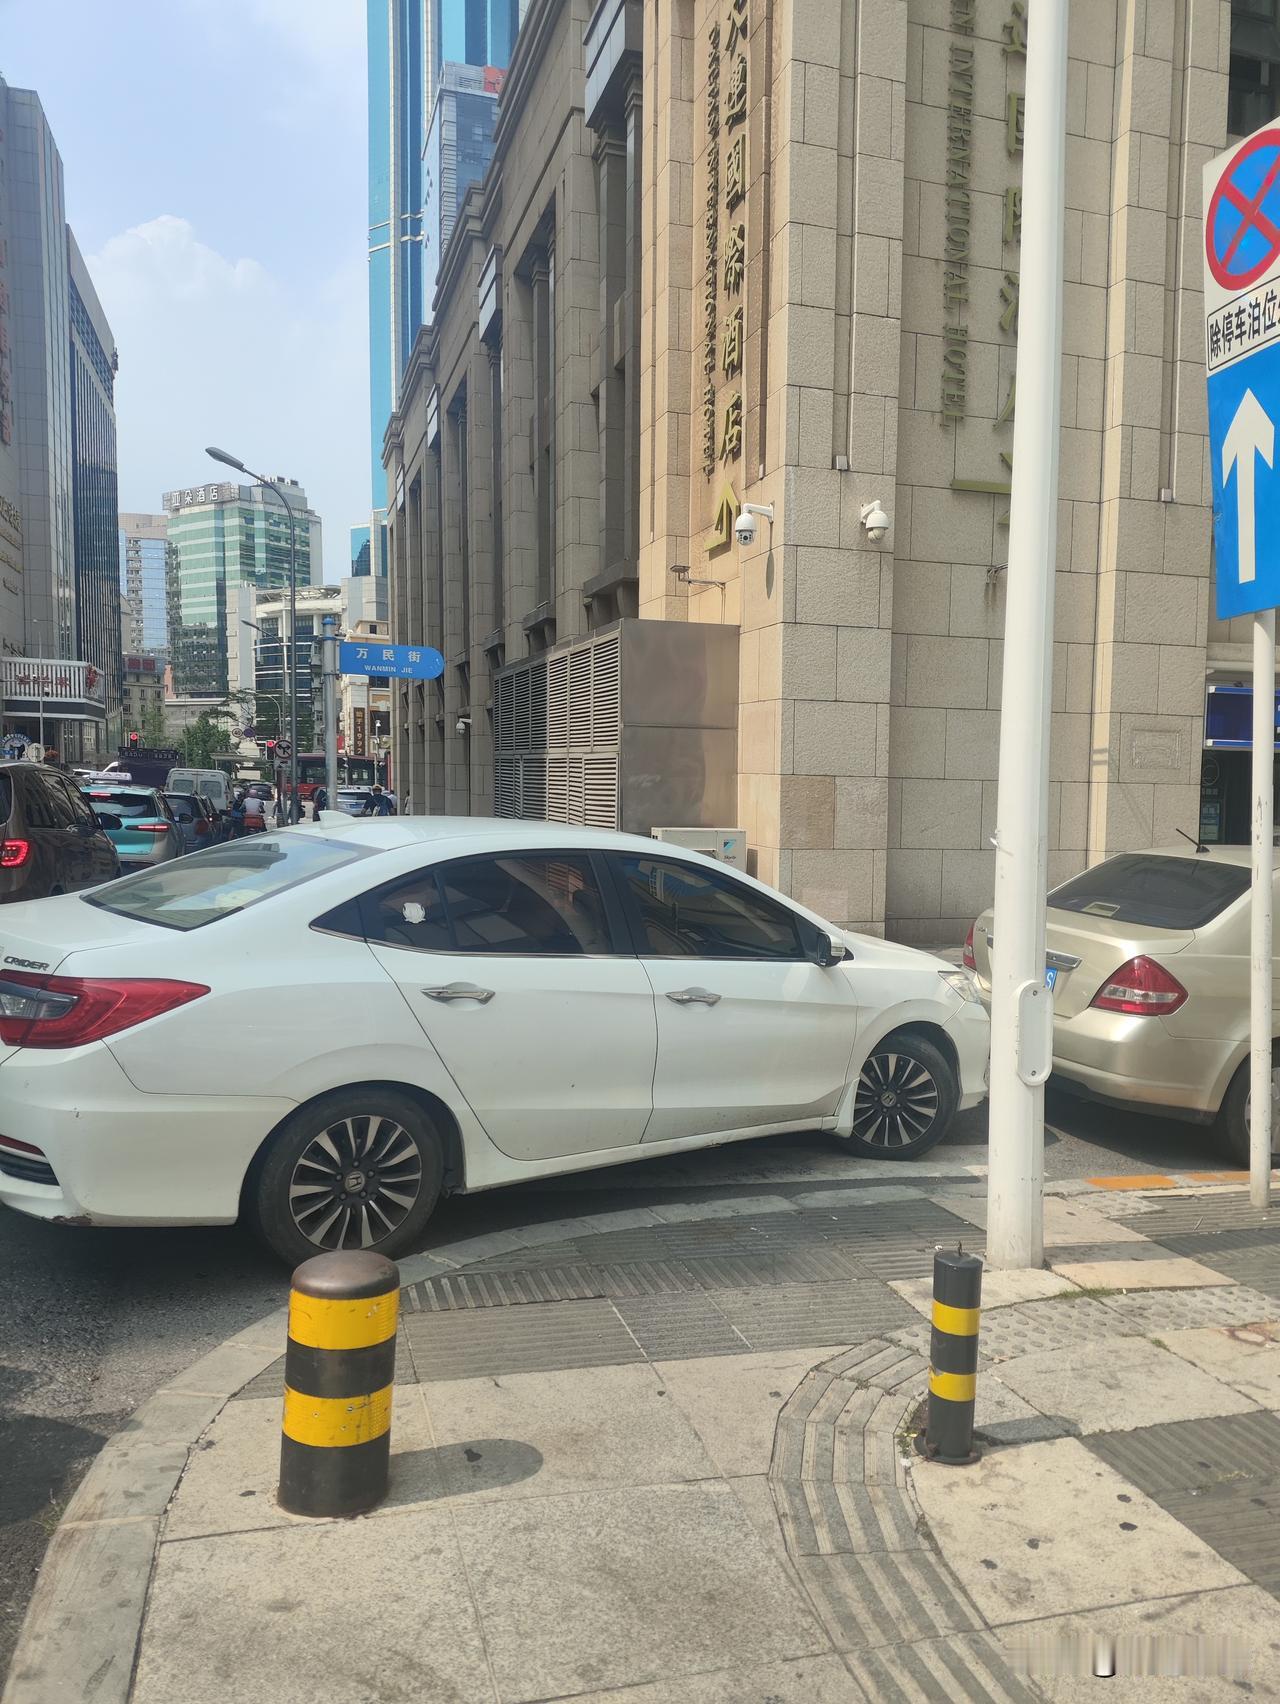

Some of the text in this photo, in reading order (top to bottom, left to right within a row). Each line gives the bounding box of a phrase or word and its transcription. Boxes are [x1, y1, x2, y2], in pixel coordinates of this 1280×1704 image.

[944, 41, 974, 309] INTERNATIONAL
[1210, 288, 1280, 361] 除停车泊位
[941, 323, 969, 429] HOTEL
[172, 486, 218, 506] 亚朵酒店
[356, 648, 421, 663] 万民街
[364, 664, 396, 672] WANMIN
[4, 956, 50, 971] CRIDER
